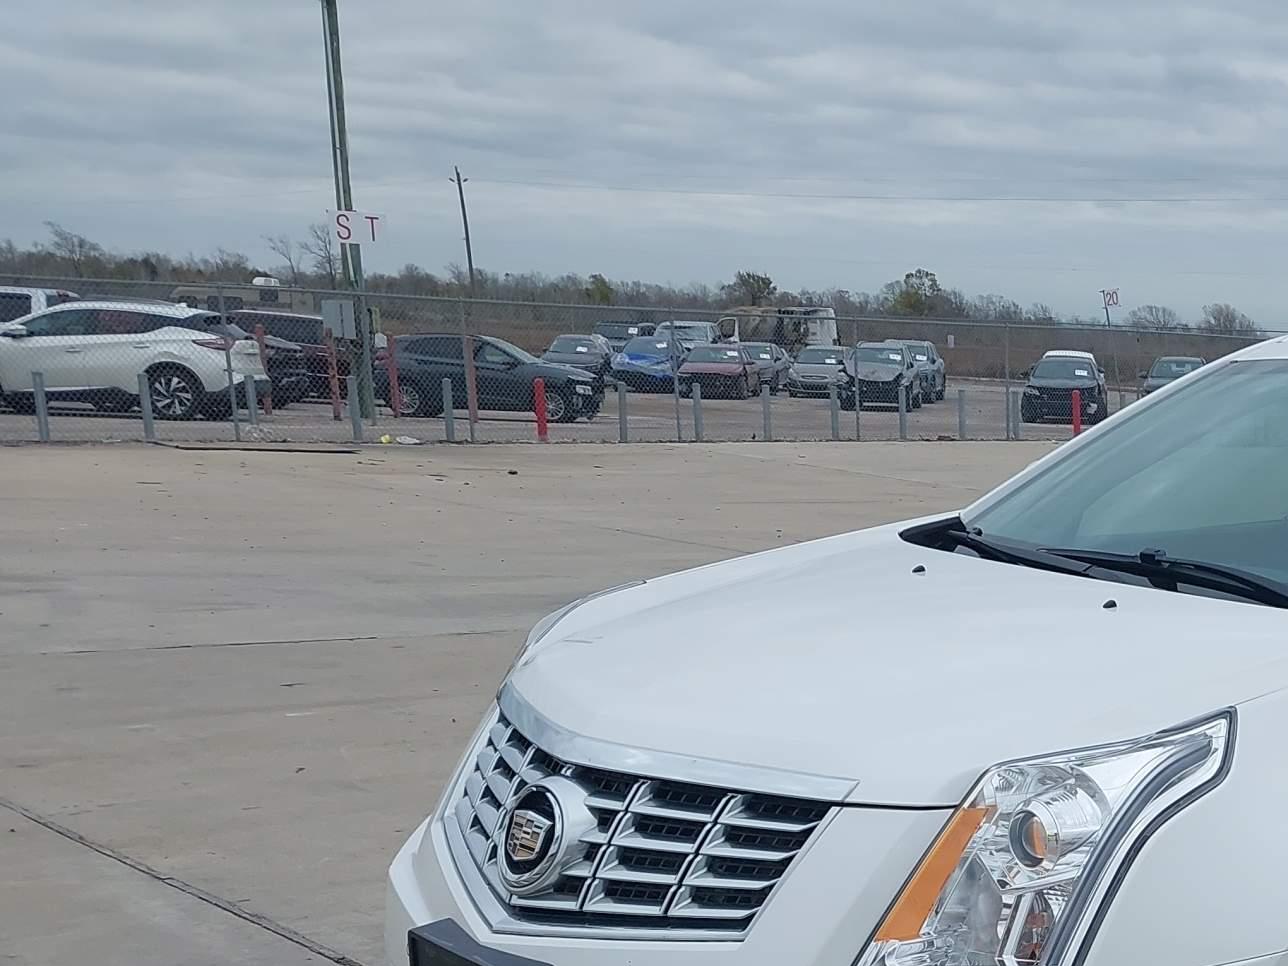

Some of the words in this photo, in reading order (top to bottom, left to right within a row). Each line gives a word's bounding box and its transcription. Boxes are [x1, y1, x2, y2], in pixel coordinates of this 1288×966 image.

[335, 213, 352, 240] S
[364, 215, 380, 242] T
[1105, 290, 1119, 306] 20
